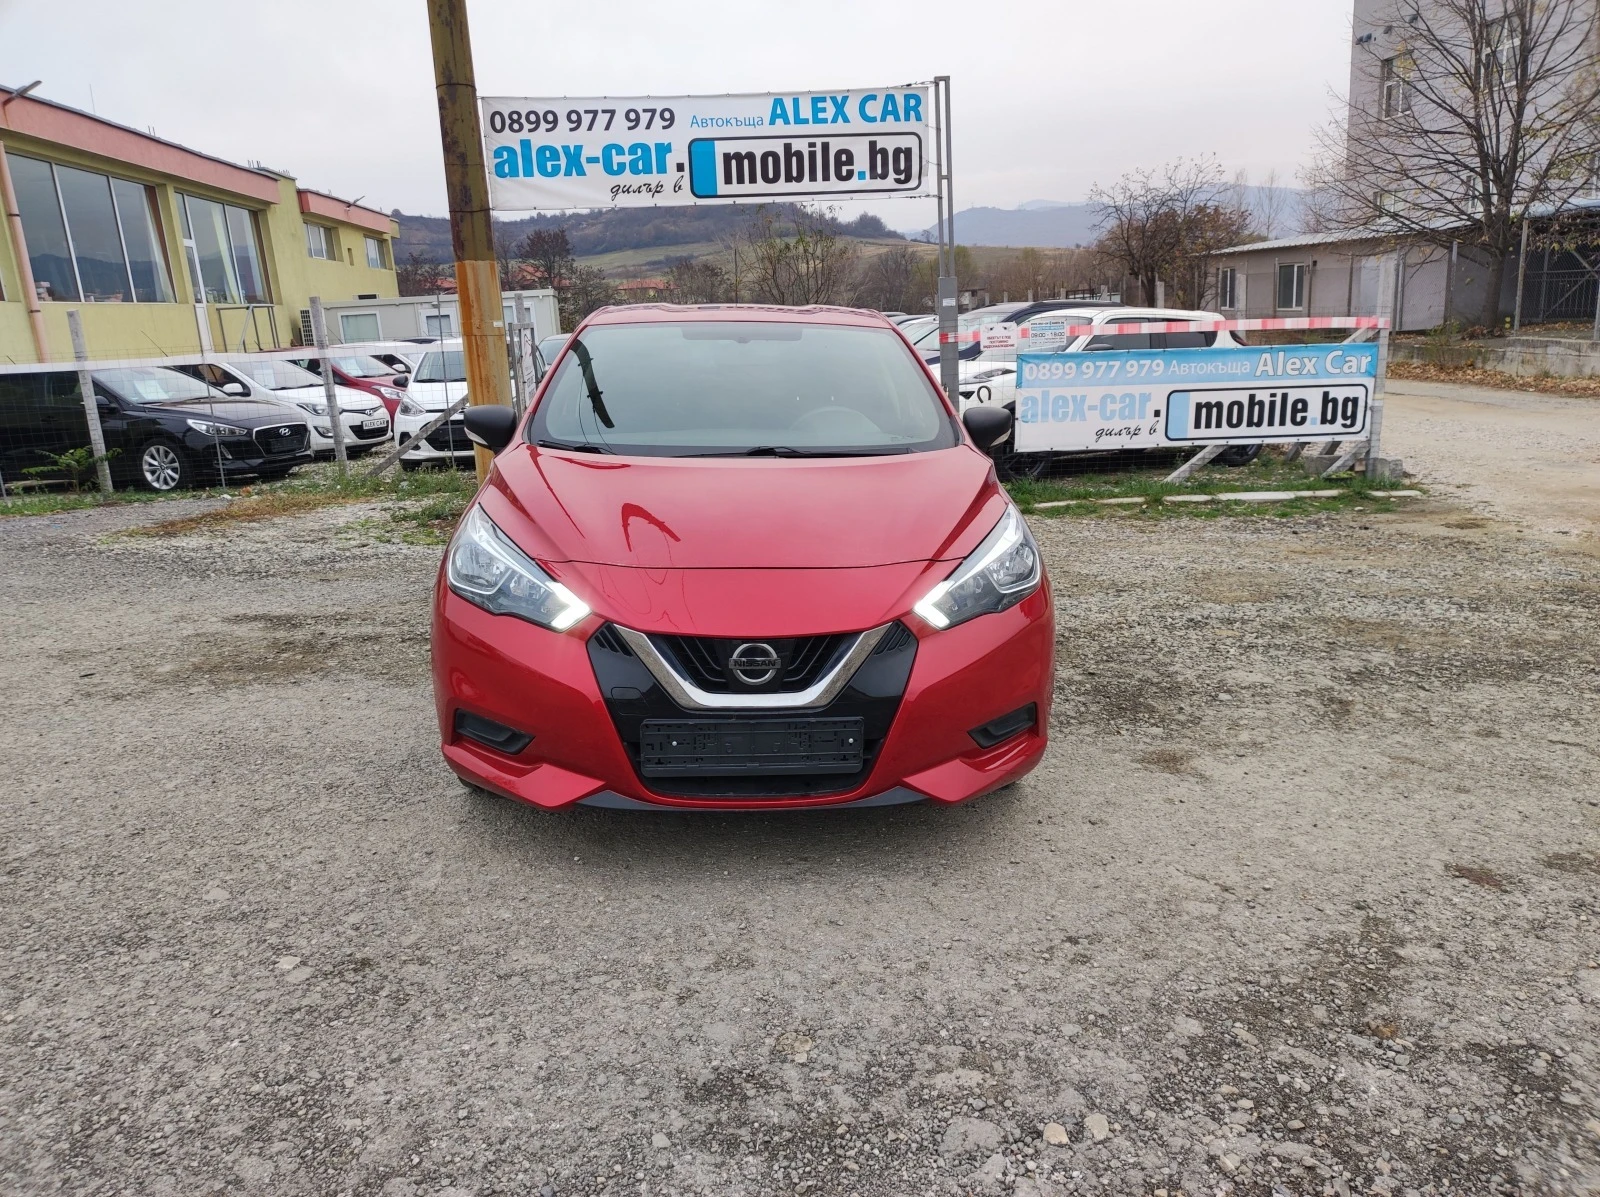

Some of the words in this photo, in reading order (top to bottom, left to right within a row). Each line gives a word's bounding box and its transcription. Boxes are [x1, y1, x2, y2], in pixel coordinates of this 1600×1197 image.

[489, 109, 559, 134] 0899
[566, 108, 617, 132] 977
[624, 107, 676, 130] 979
[690, 114, 764, 129] Автокъща
[768, 95, 850, 126] ALEX
[858, 93, 923, 123] CAR
[722, 140, 913, 185] mobile.bg
[610, 179, 665, 201] дилър
[1024, 361, 1077, 381] 0899
[1081, 360, 1121, 379] 977
[1125, 359, 1165, 378] 979
[1168, 359, 1250, 375] Автокъща
[1254, 350, 1319, 377] Alex
[1325, 350, 1372, 374] Car
[1193, 390, 1360, 429] mobile.bg
[1095, 424, 1142, 443] дилър
